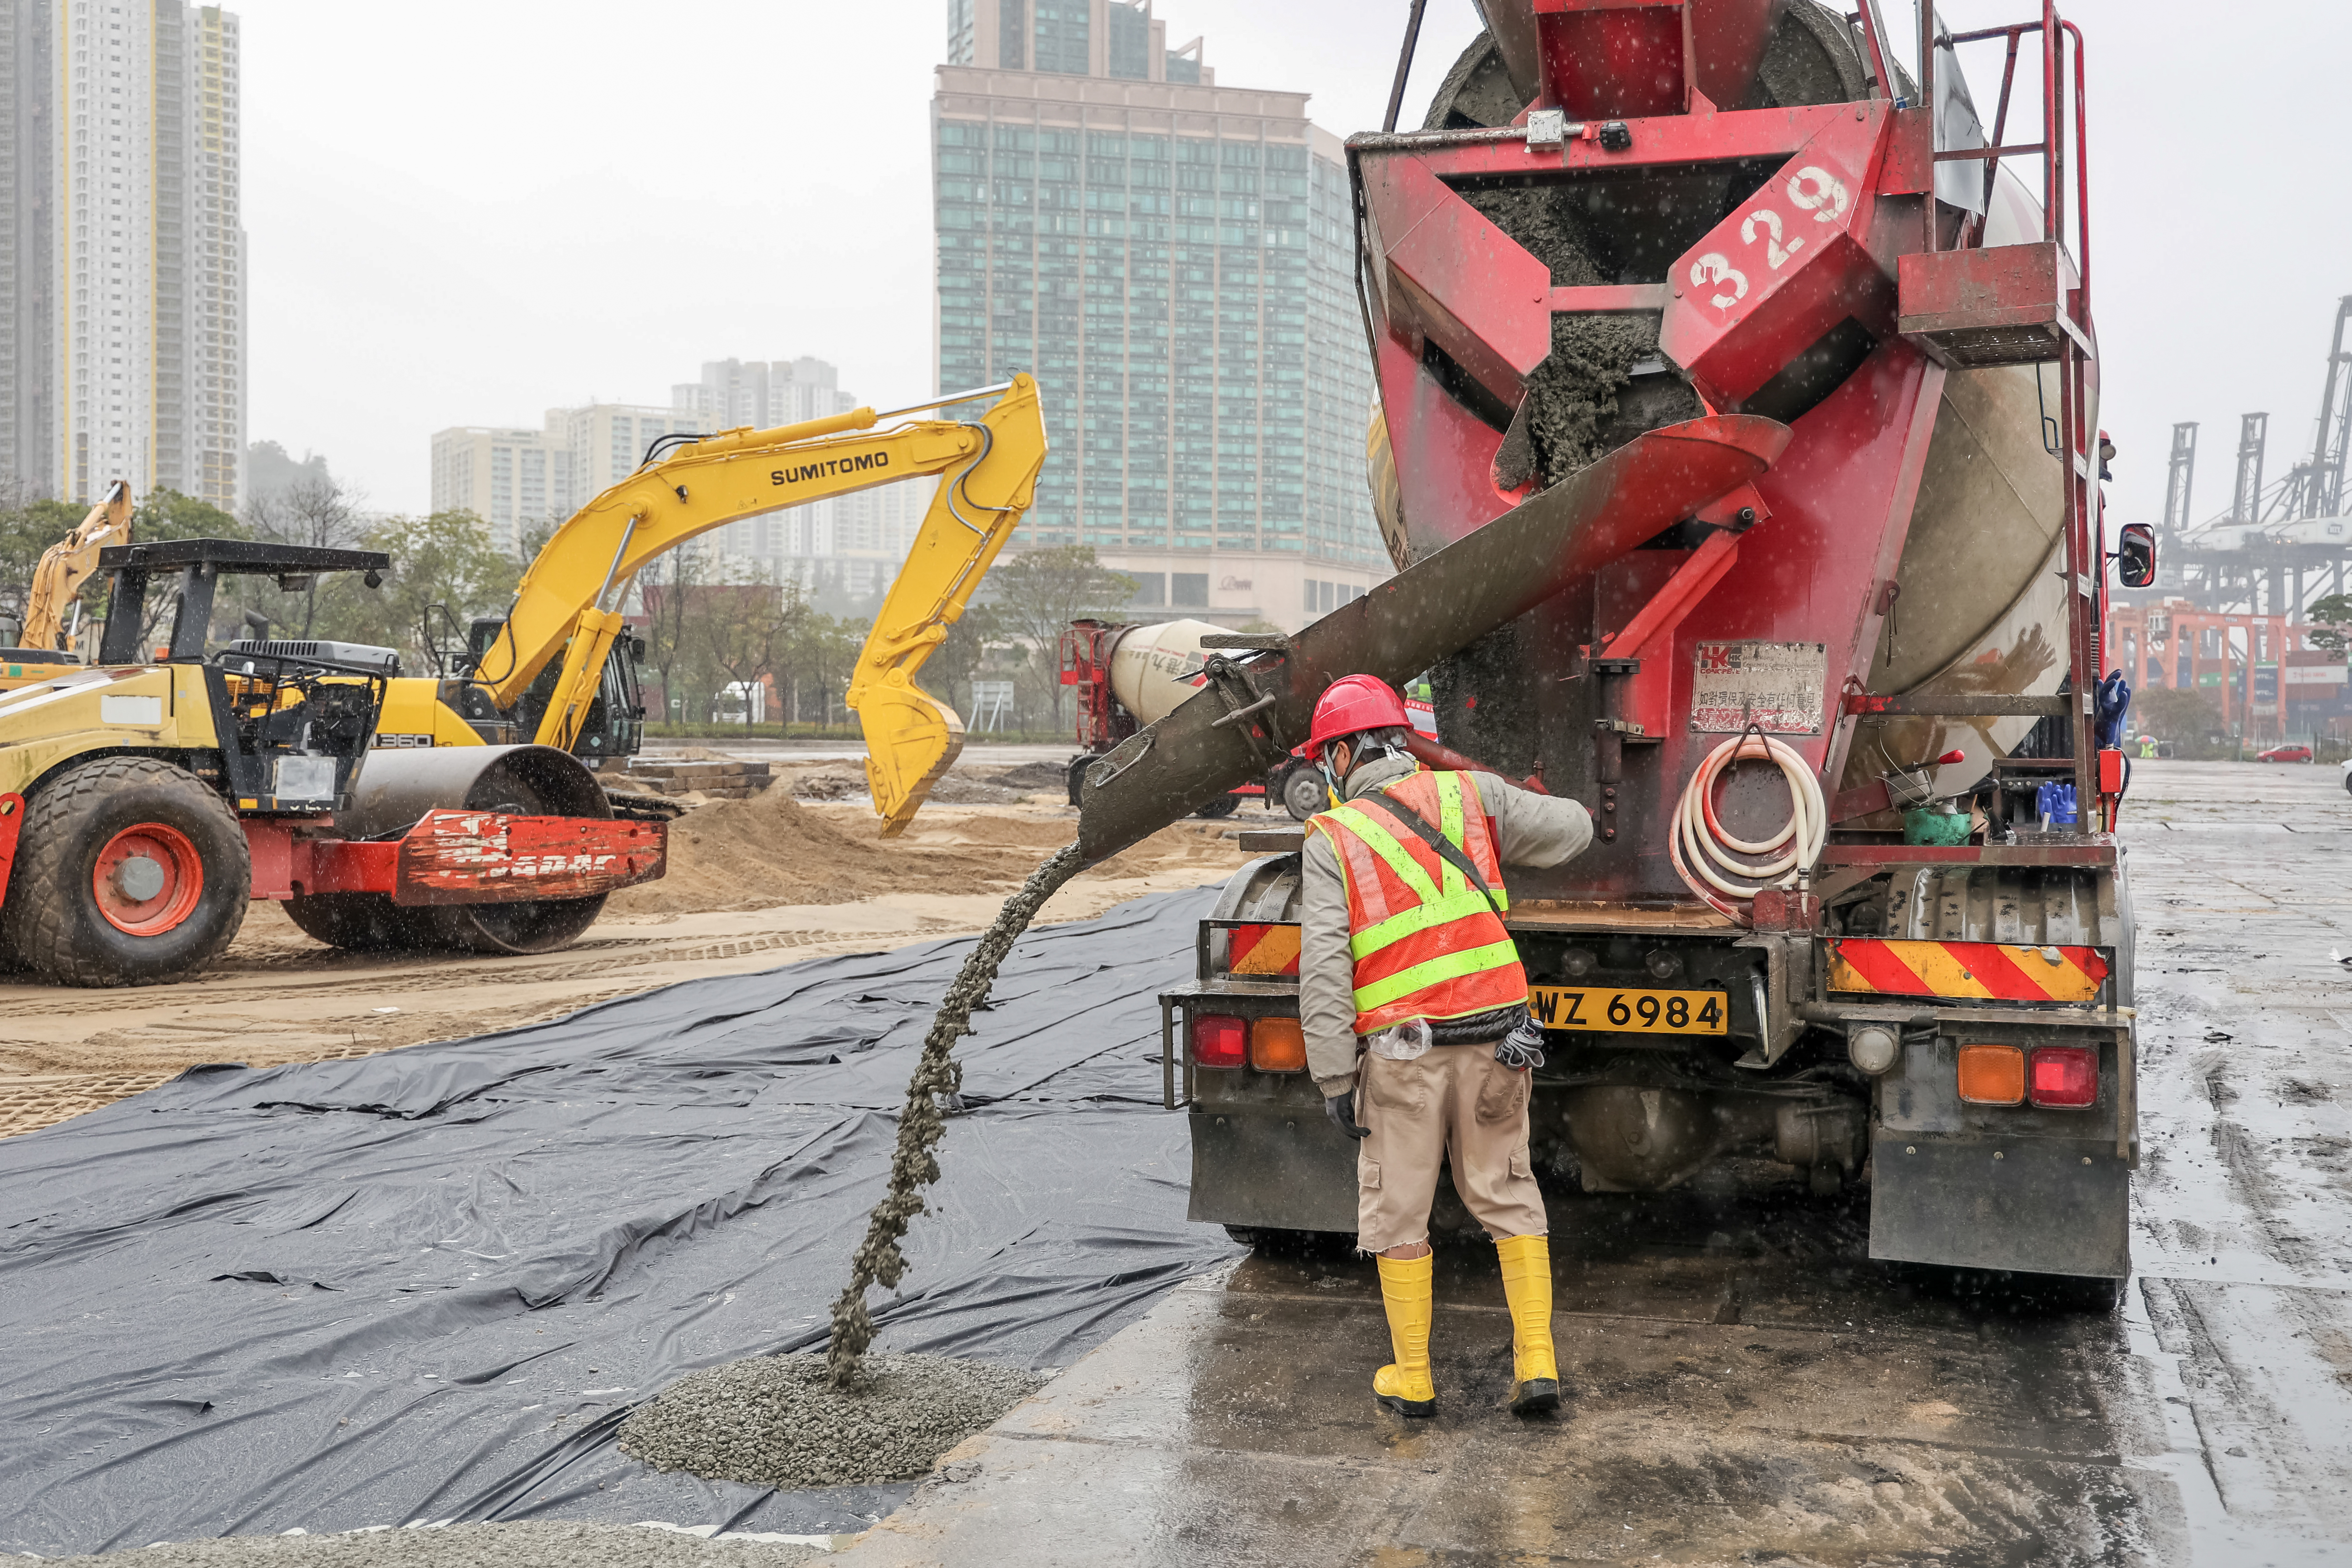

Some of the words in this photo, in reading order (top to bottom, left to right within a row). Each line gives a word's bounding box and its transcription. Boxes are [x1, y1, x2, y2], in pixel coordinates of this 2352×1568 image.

[1690, 166, 1849, 310] 329
[771, 451, 889, 486] SUMITOMO
[1699, 690, 1815, 709] 如對環保及安全有任何意見
[1535, 991, 1587, 1026] WZ
[1607, 994, 1724, 1029] 6984
